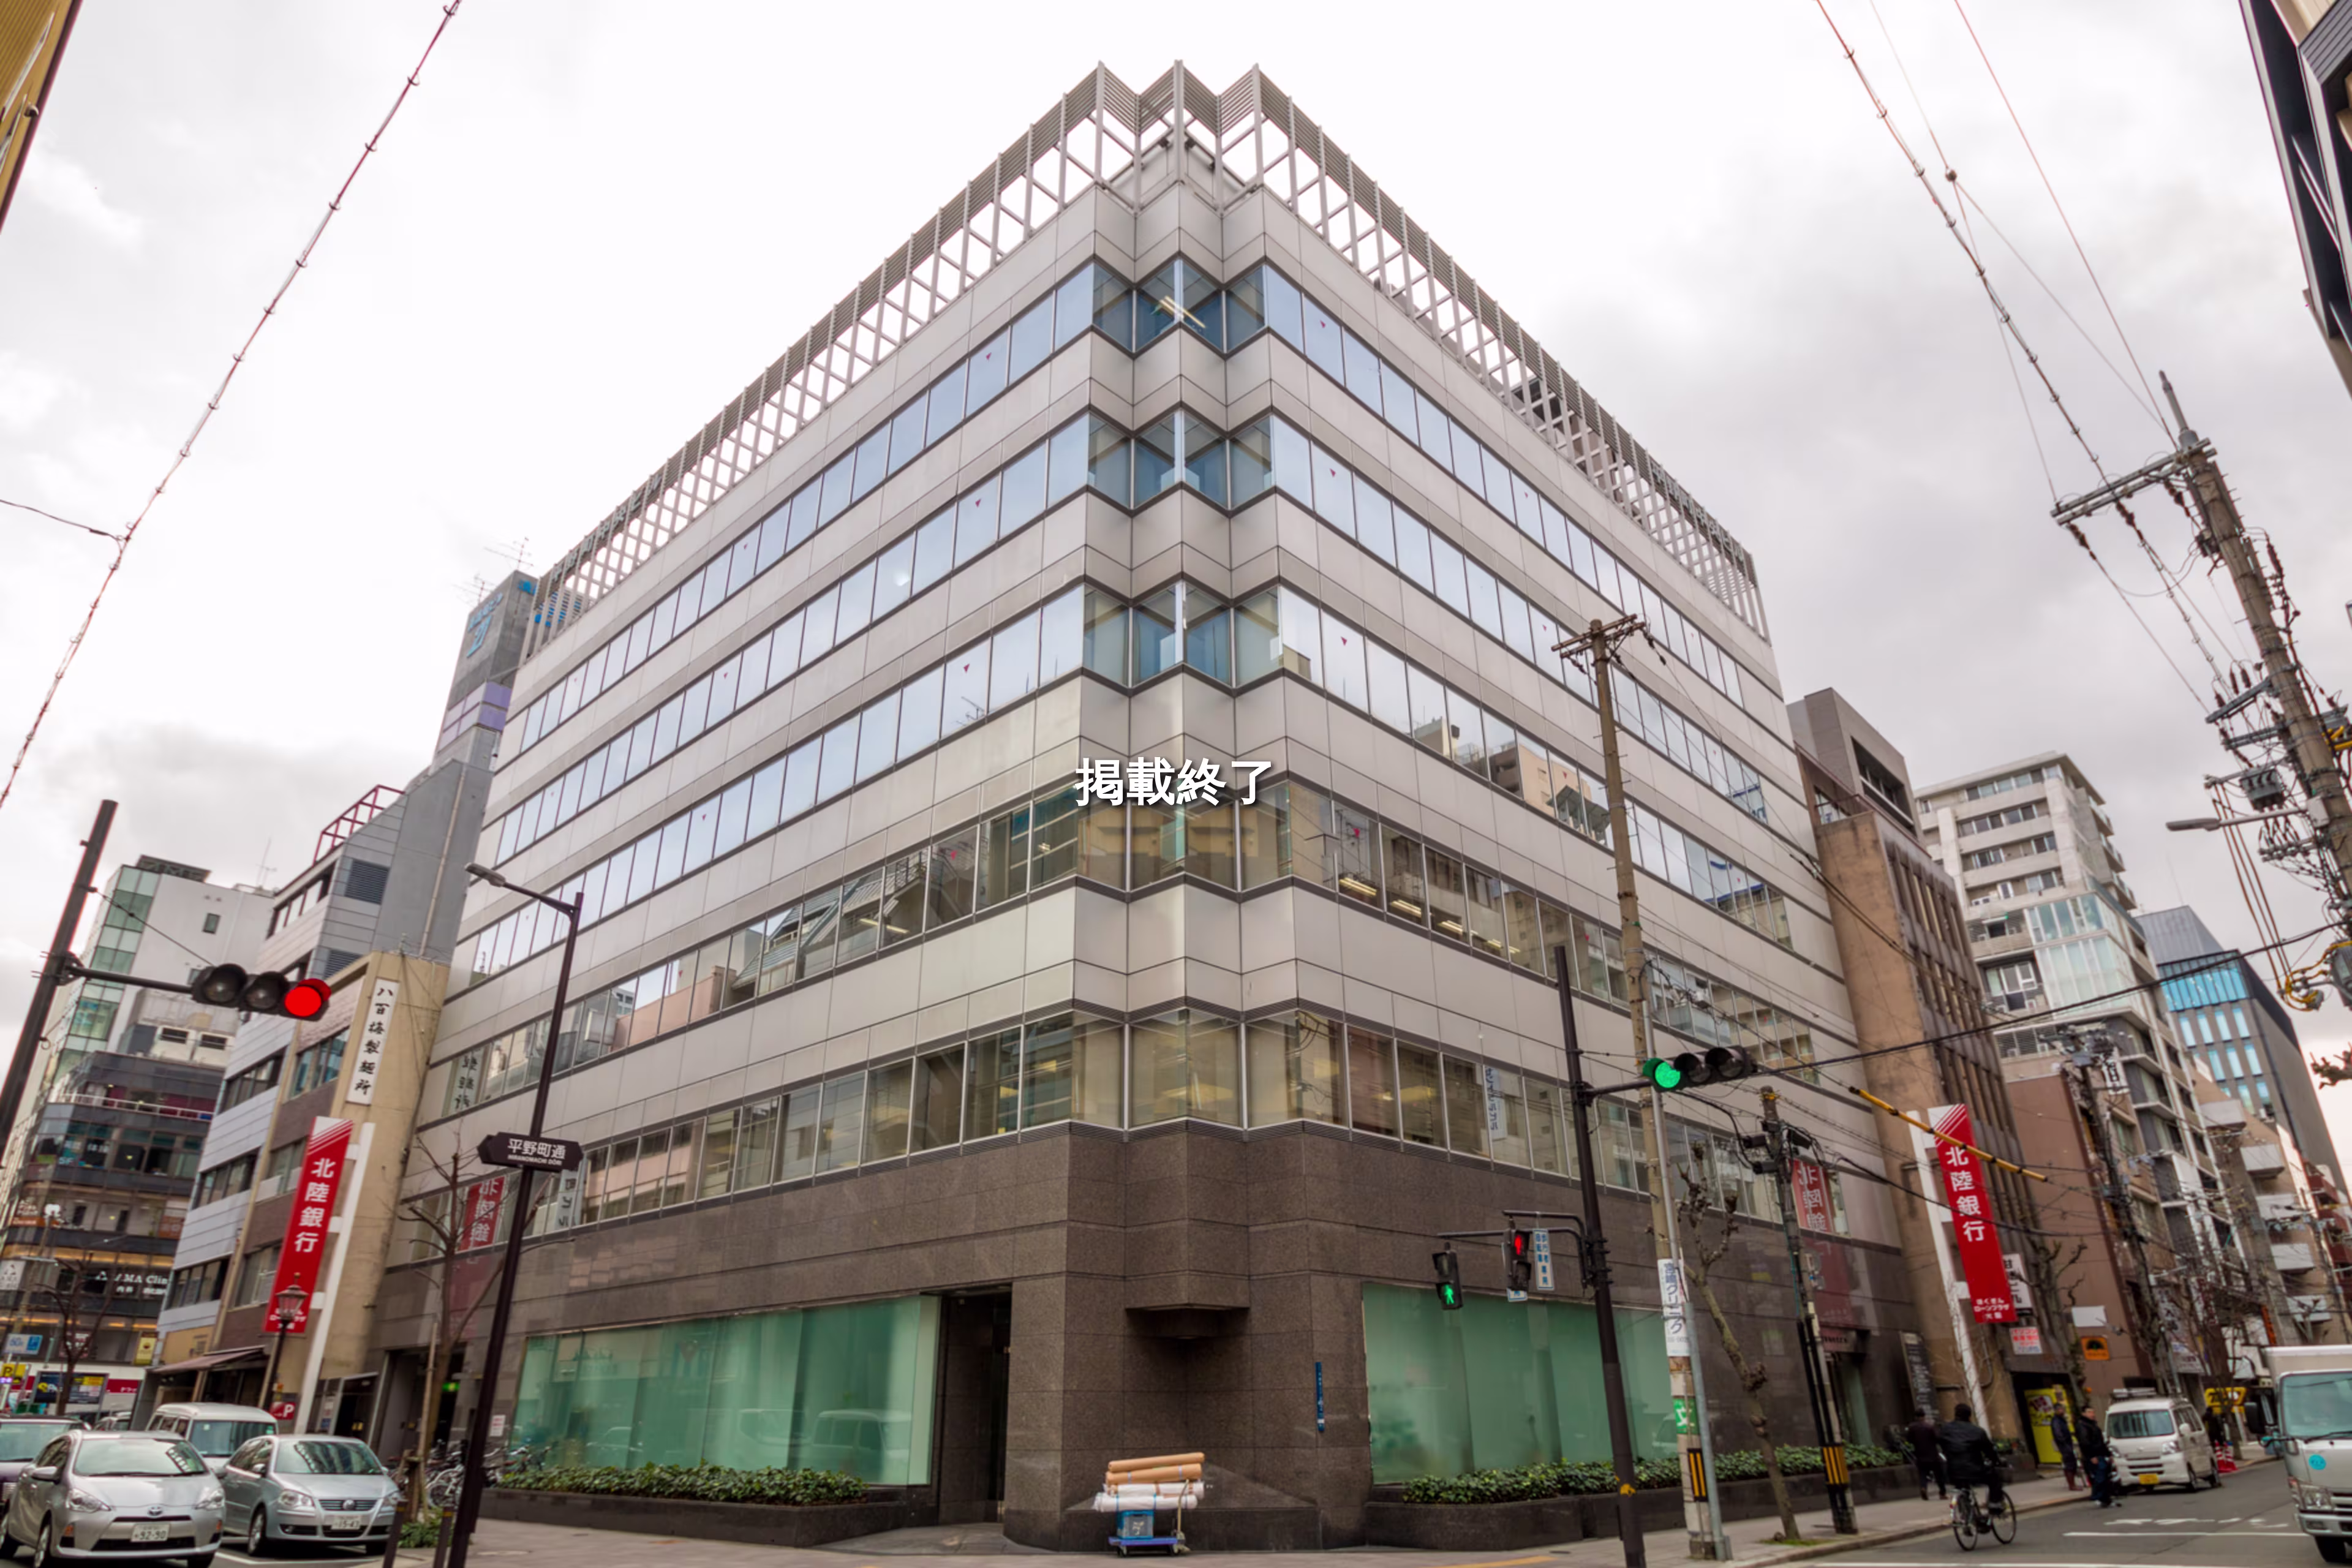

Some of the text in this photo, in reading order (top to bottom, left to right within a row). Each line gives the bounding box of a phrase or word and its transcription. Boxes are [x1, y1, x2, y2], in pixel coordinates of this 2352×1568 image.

[507, 1138, 566, 1159] 平野町通
[294, 1158, 336, 1253] 北陸銀行
[1945, 1146, 1986, 1242] 北陸銀行
[283, 1404, 295, 1417] P
